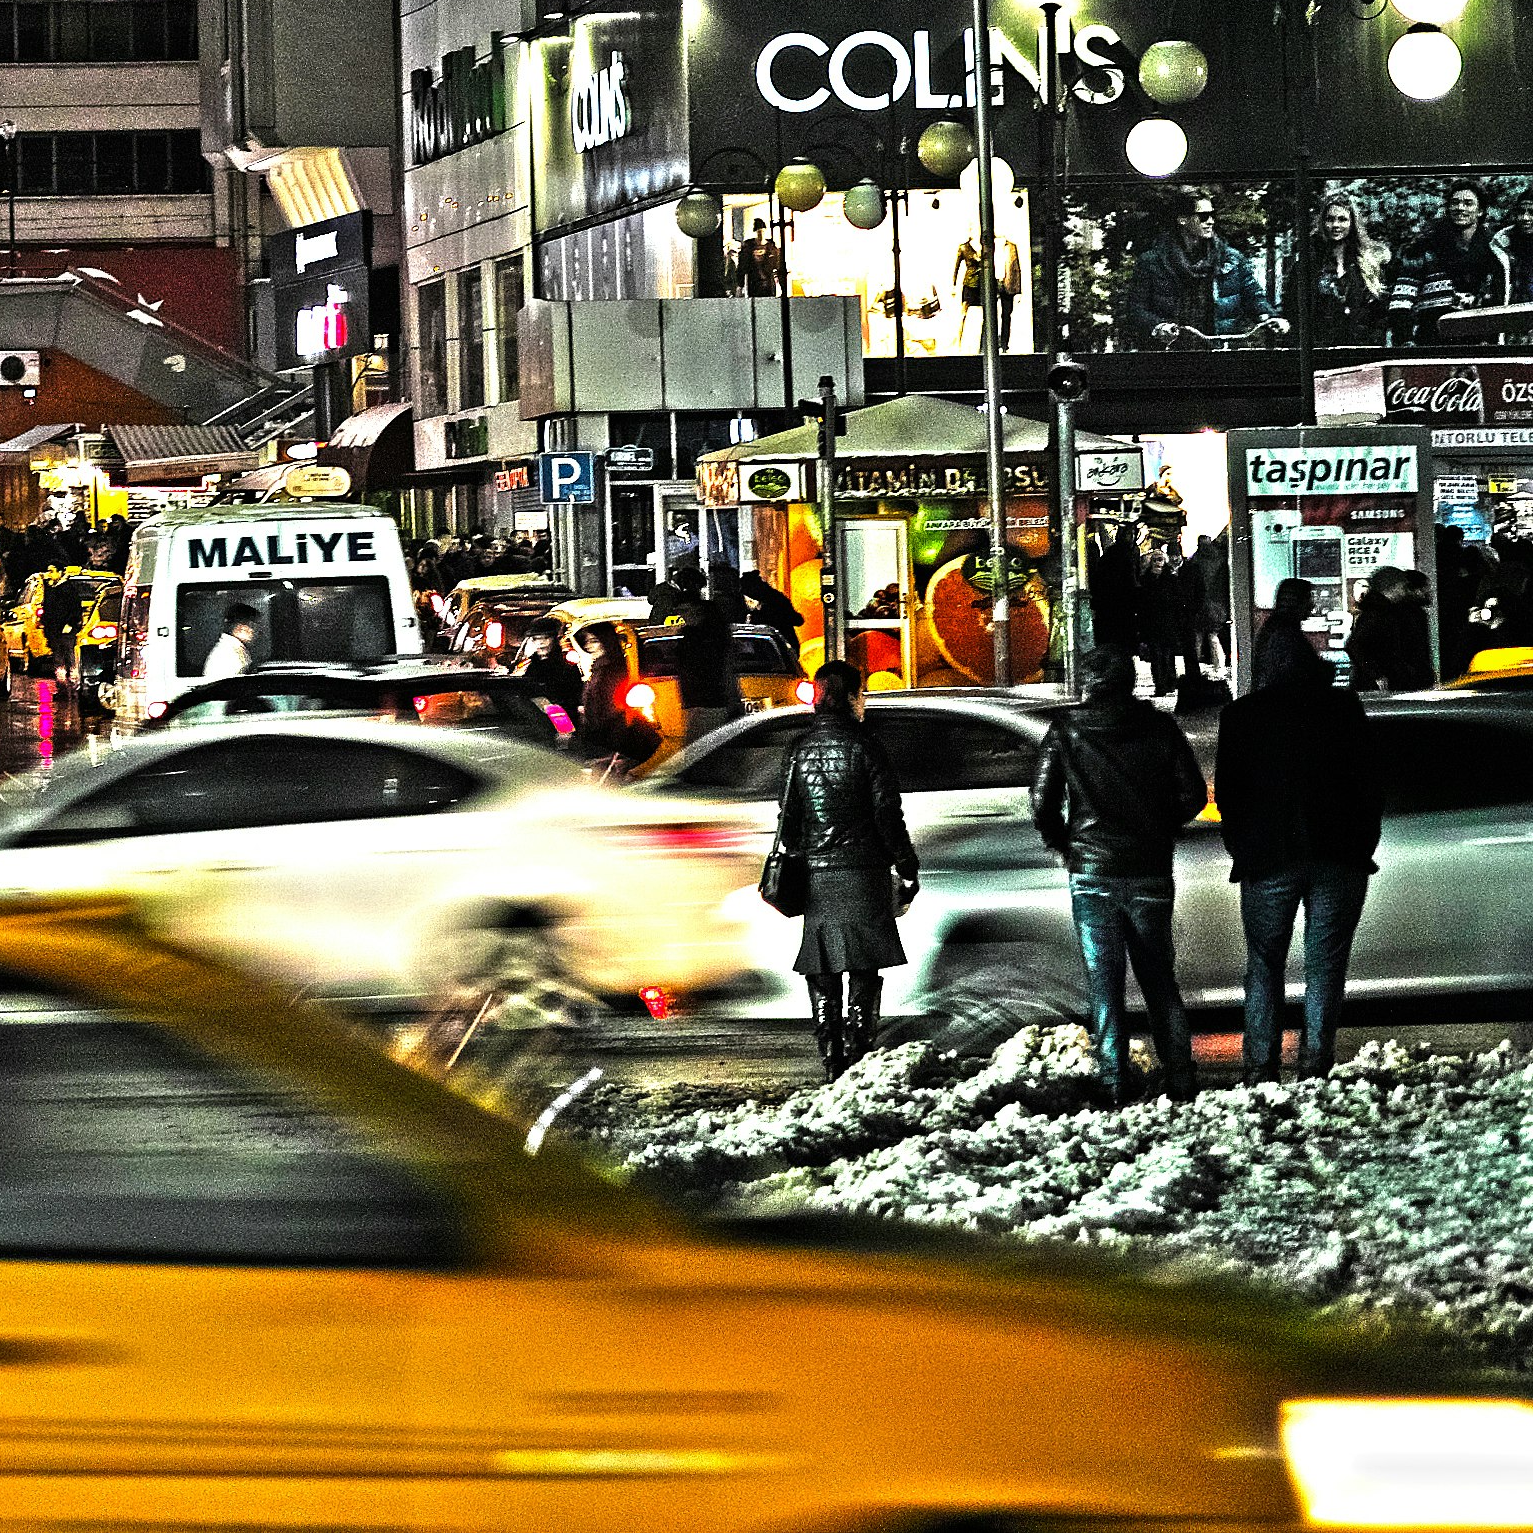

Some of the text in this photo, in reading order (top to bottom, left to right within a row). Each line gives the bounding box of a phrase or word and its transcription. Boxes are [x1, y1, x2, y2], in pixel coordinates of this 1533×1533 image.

[1386, 375, 1482, 414] Coca-Cola
[551, 457, 582, 500] P
[1249, 454, 1411, 491] taşpınar
[1350, 509, 1406, 520] SAMSUNG
[1347, 537, 1390, 548] Galaxy
